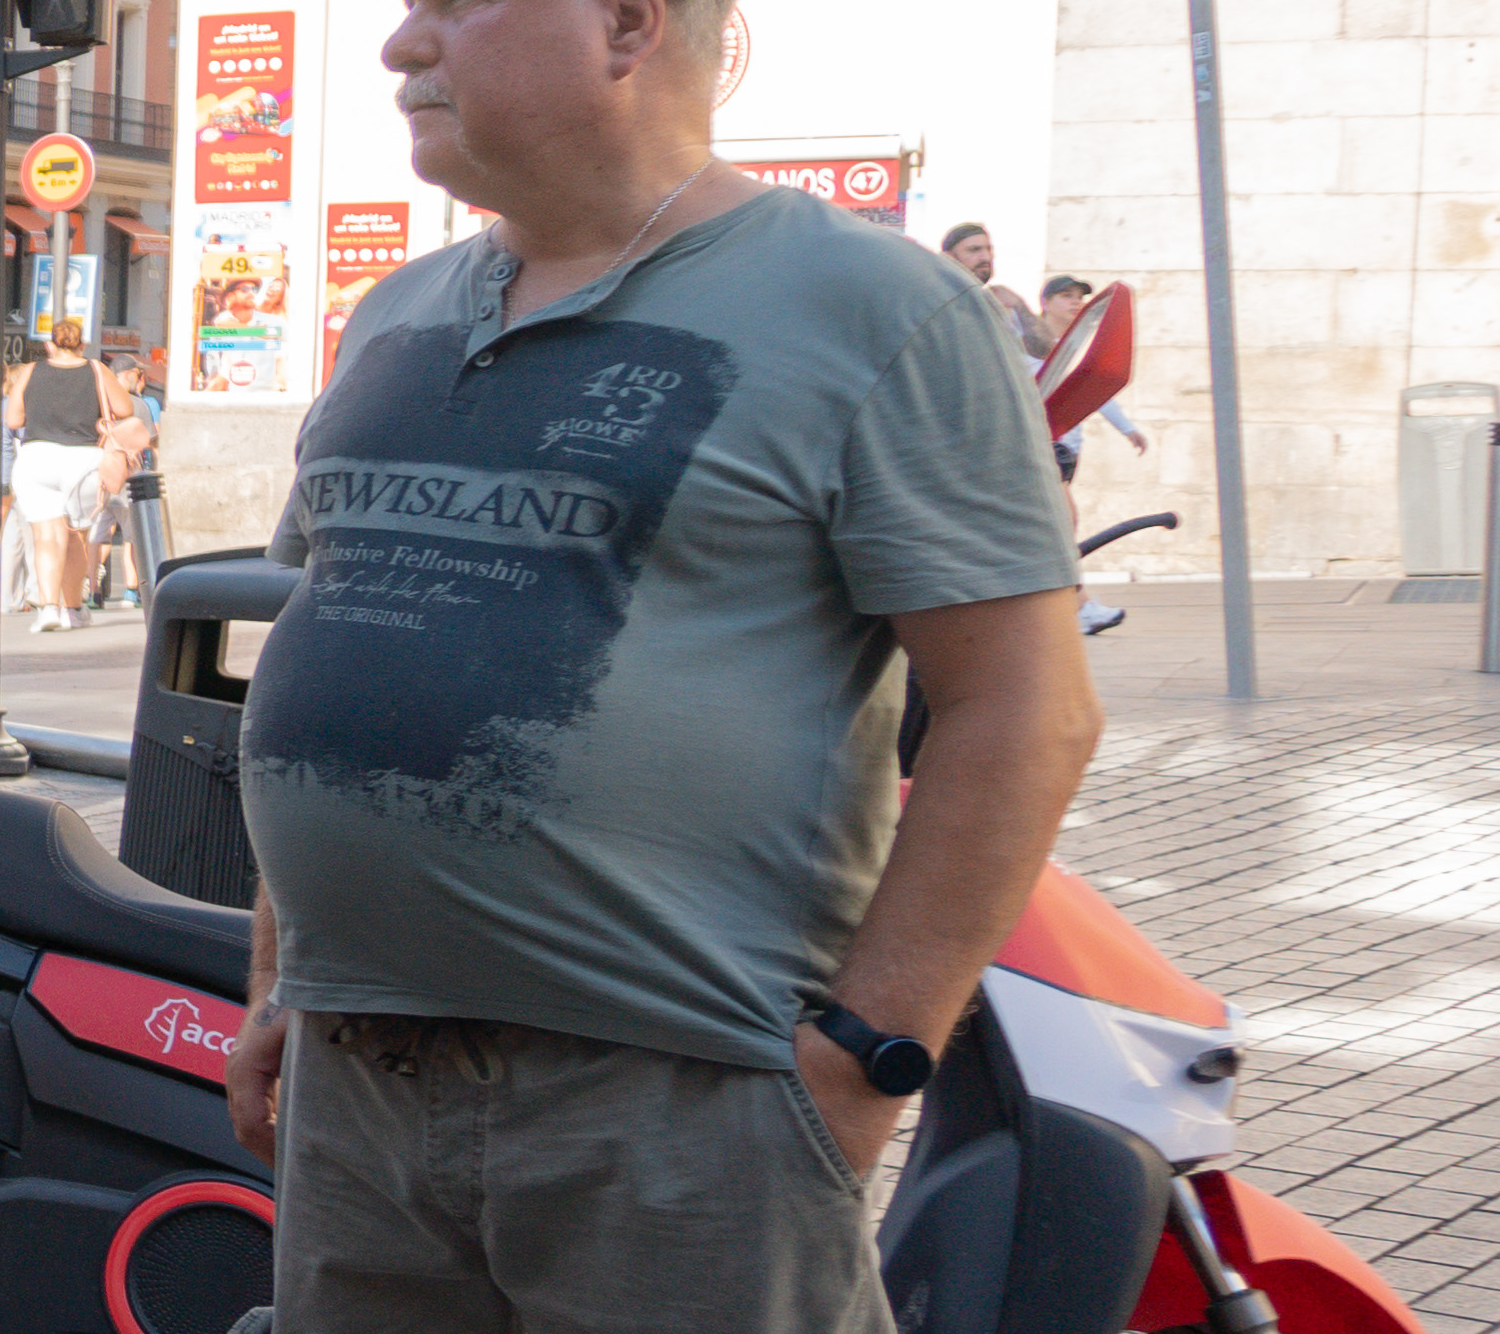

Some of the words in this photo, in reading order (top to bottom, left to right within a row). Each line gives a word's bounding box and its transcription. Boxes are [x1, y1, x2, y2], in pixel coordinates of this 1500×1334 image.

[850, 170, 881, 193] 47
[301, 470, 620, 539] NEWISLAND
[387, 545, 540, 591] Fellowship
[316, 605, 345, 623] THE
[345, 605, 426, 632] ORIGINAL
